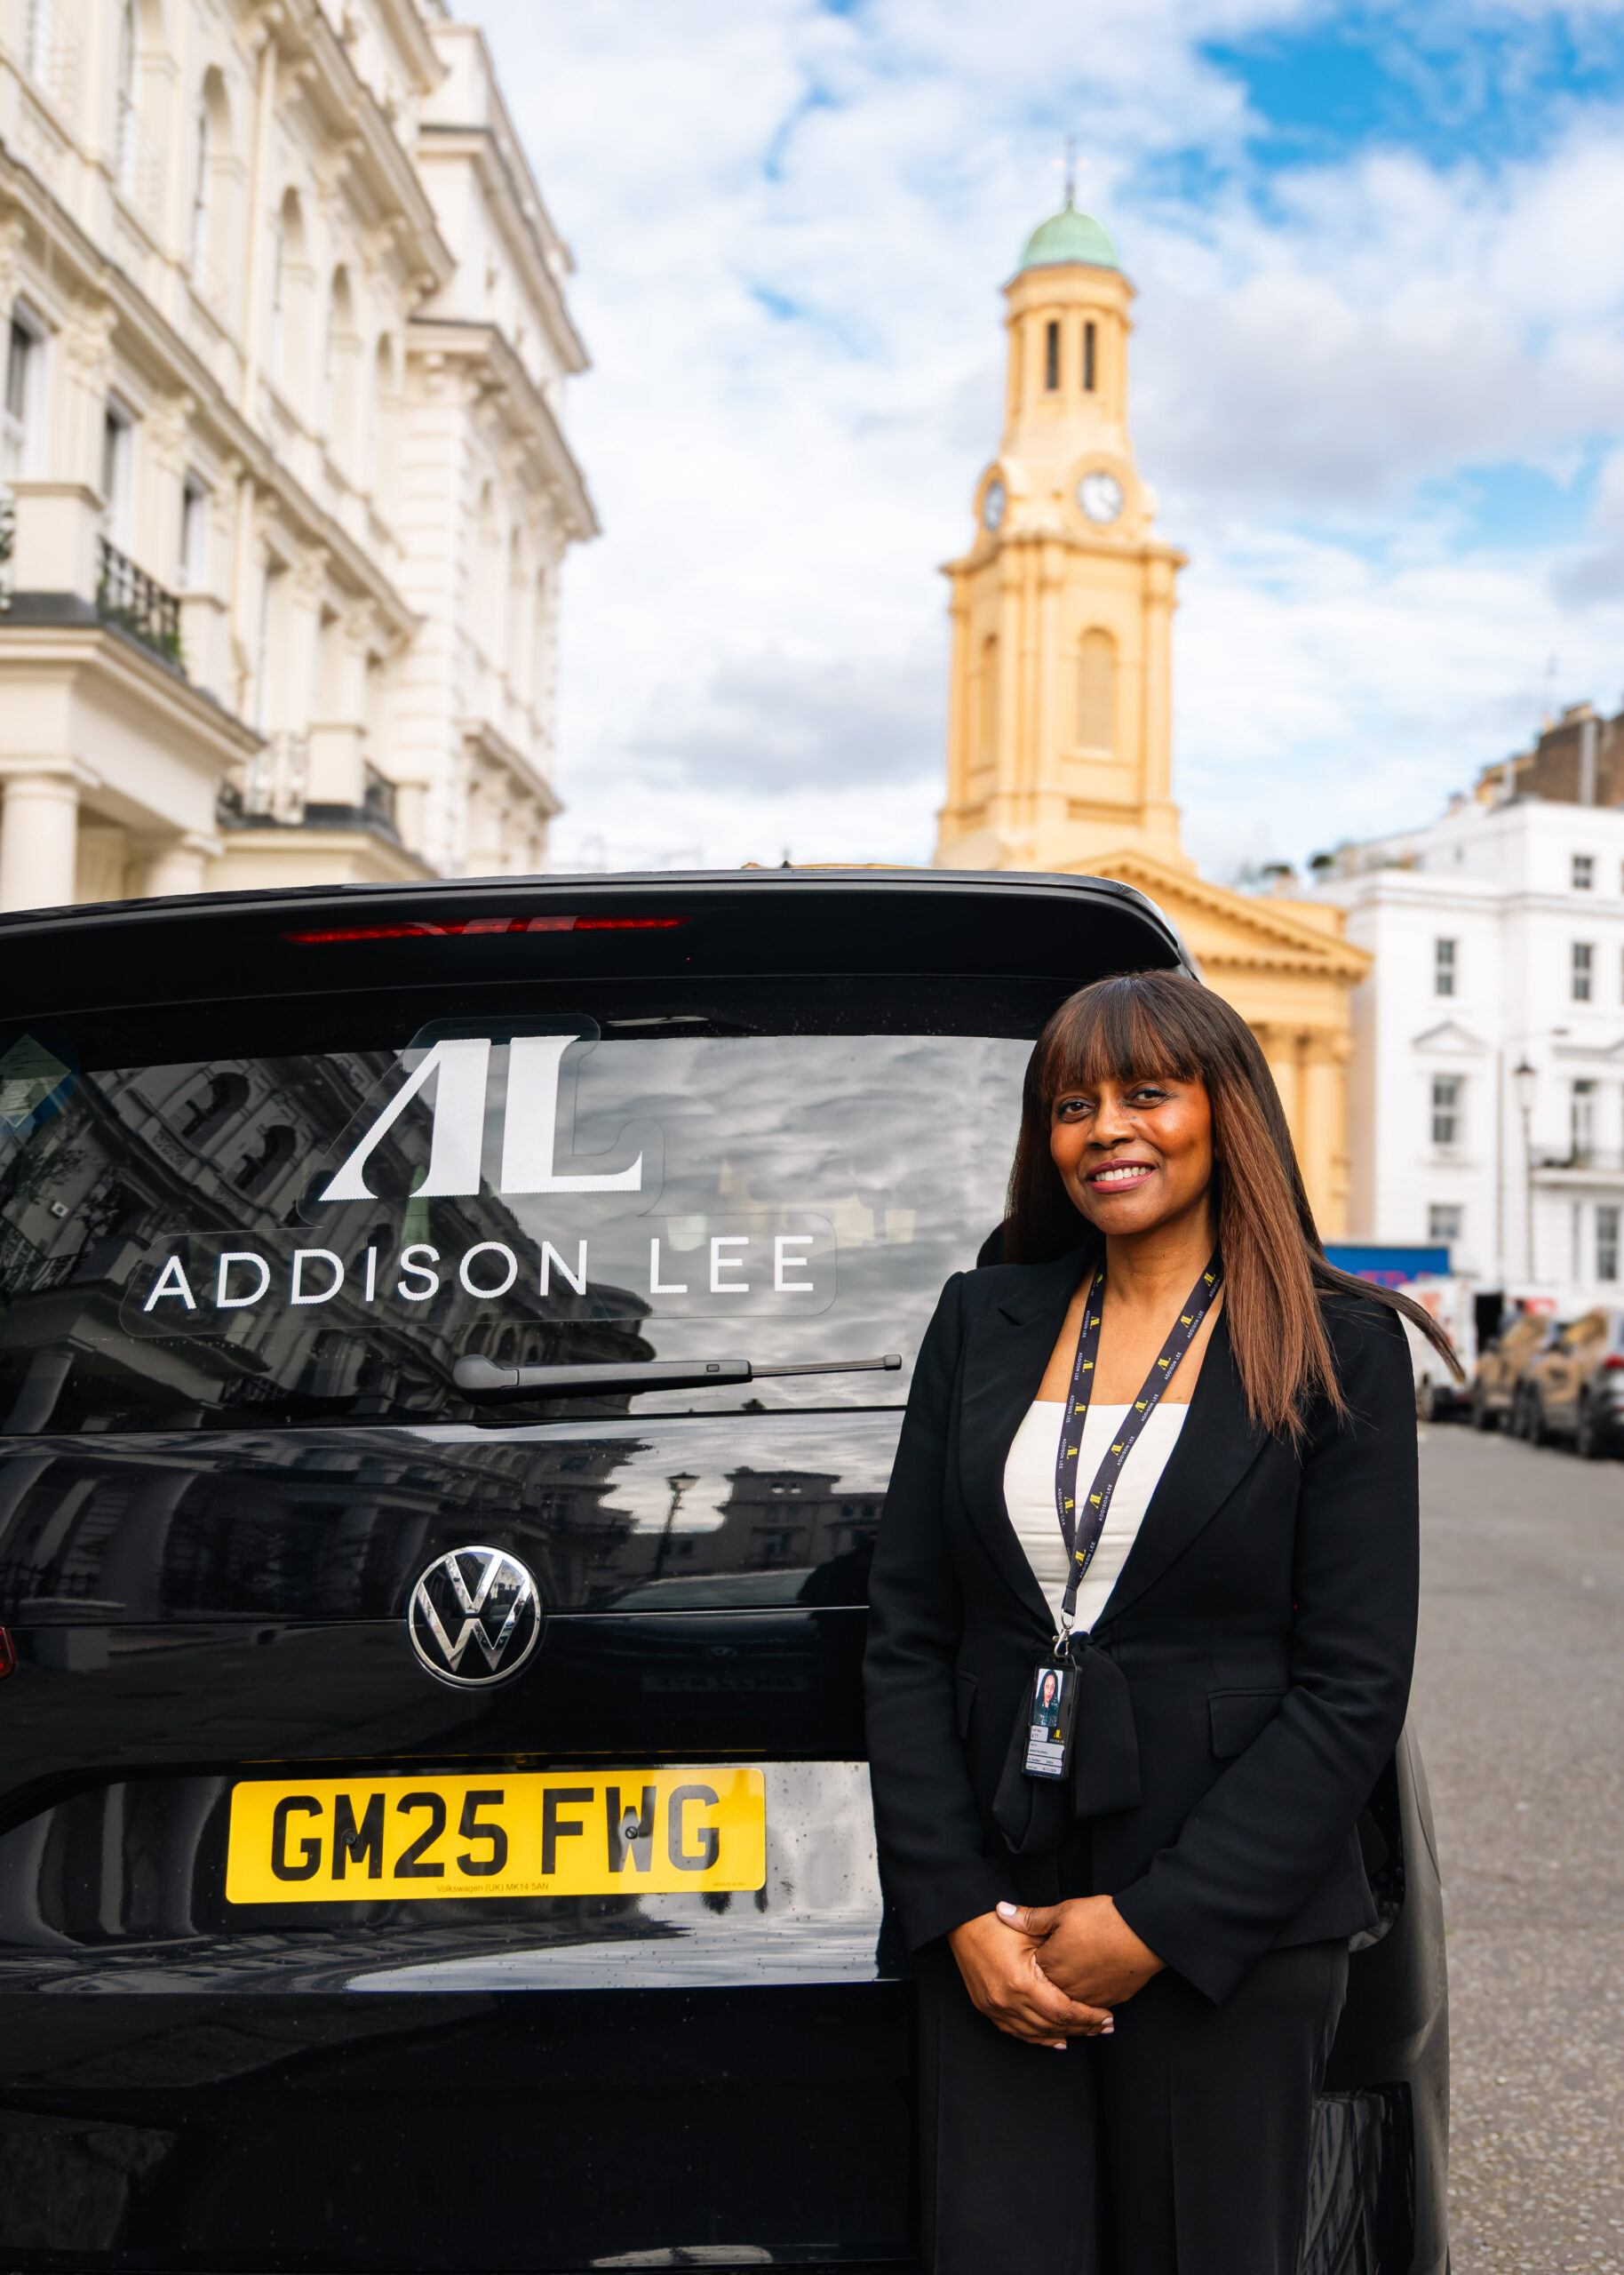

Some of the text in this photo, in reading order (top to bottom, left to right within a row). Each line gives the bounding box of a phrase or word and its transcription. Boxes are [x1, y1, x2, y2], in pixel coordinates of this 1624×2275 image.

[144, 1235, 814, 1312] ADDISON LEE
[413, 1551, 536, 1673] VW
[272, 1784, 720, 1881] GM25 FWG
[436, 1884, 482, 1893] Volkswagen
[485, 1884, 504, 1893] (UK)
